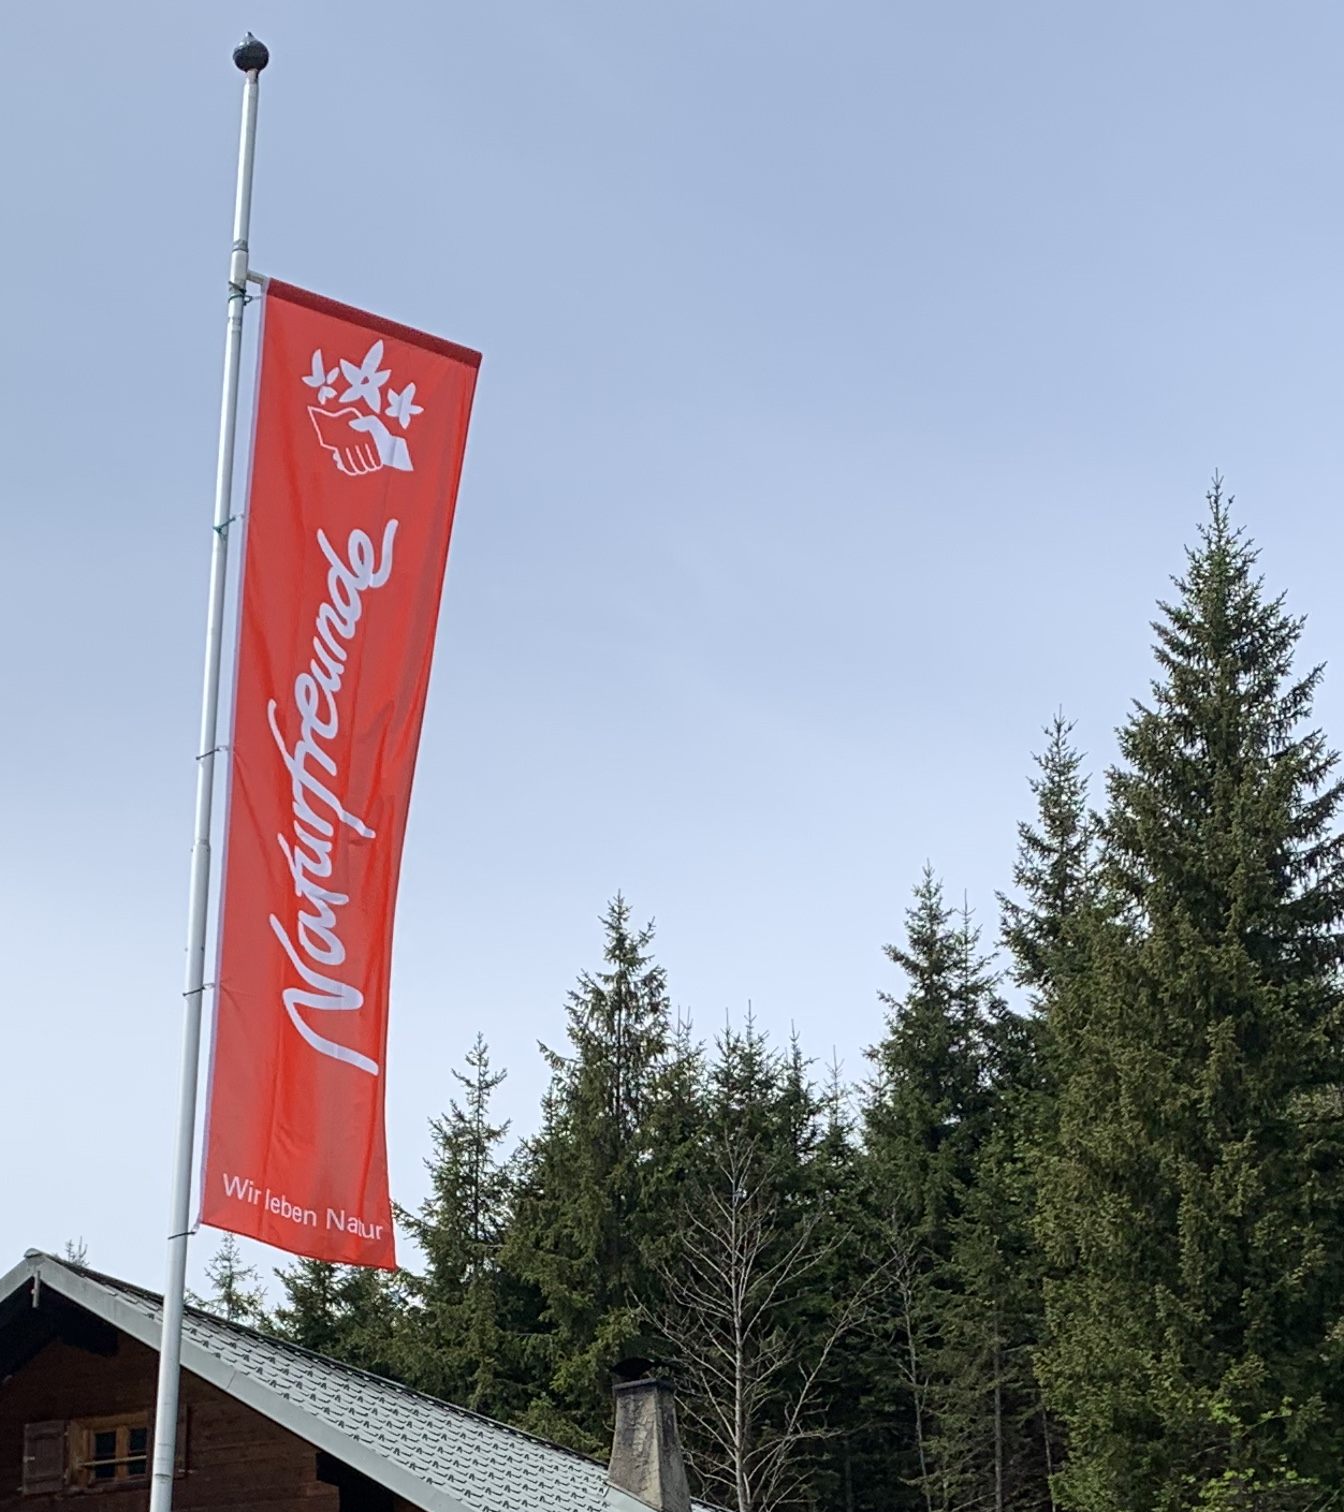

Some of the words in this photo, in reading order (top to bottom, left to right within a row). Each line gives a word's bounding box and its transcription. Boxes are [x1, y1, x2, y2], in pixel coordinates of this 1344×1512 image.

[268, 519, 399, 1076] Naturfreunde
[223, 1173, 262, 1205] Wir
[265, 1189, 317, 1227] leben
[326, 1208, 384, 1240] Natur
